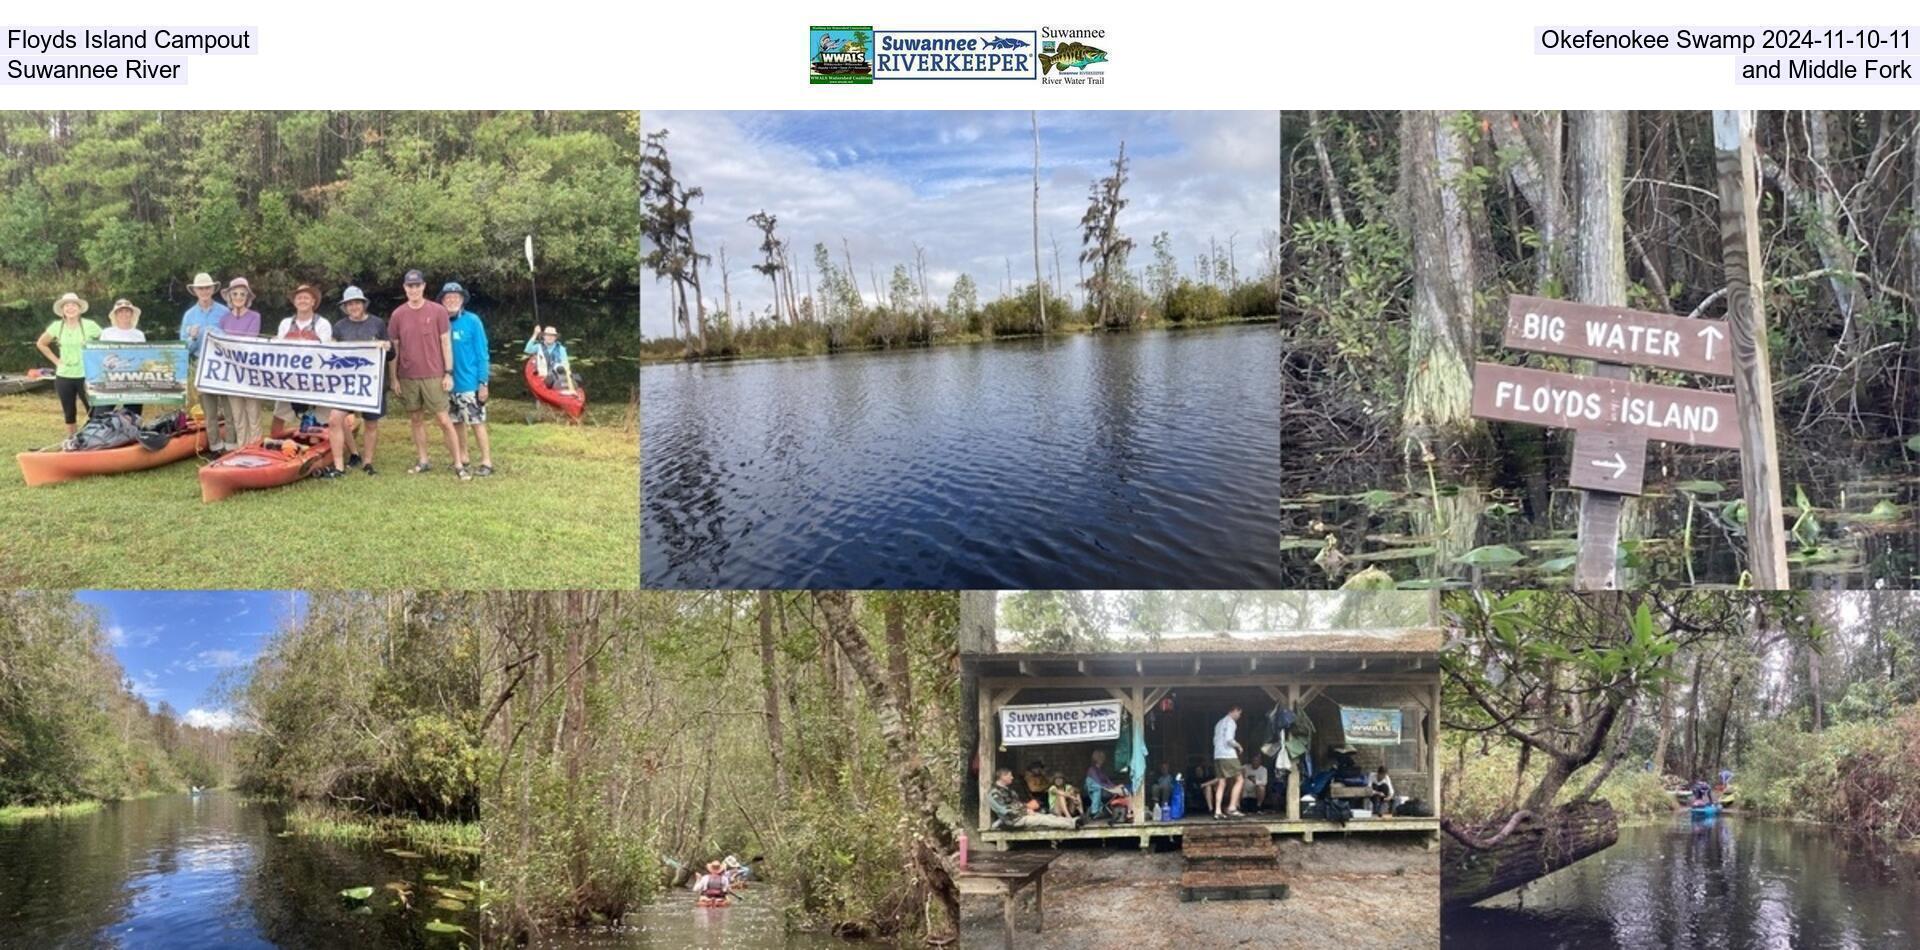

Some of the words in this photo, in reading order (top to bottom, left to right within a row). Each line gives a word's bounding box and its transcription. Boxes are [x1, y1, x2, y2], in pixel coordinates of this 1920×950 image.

[1523, 313, 1565, 342] BIG
[1585, 320, 1681, 357] WATER
[214, 342, 313, 370] Suwannee
[107, 371, 174, 382] WWALS
[1495, 382, 1601, 420] FLOYDS
[1620, 396, 1719, 433] ISLAND
[1005, 718, 1117, 738] RIVERKEEPER
[1008, 710, 1079, 723] Suwannee
